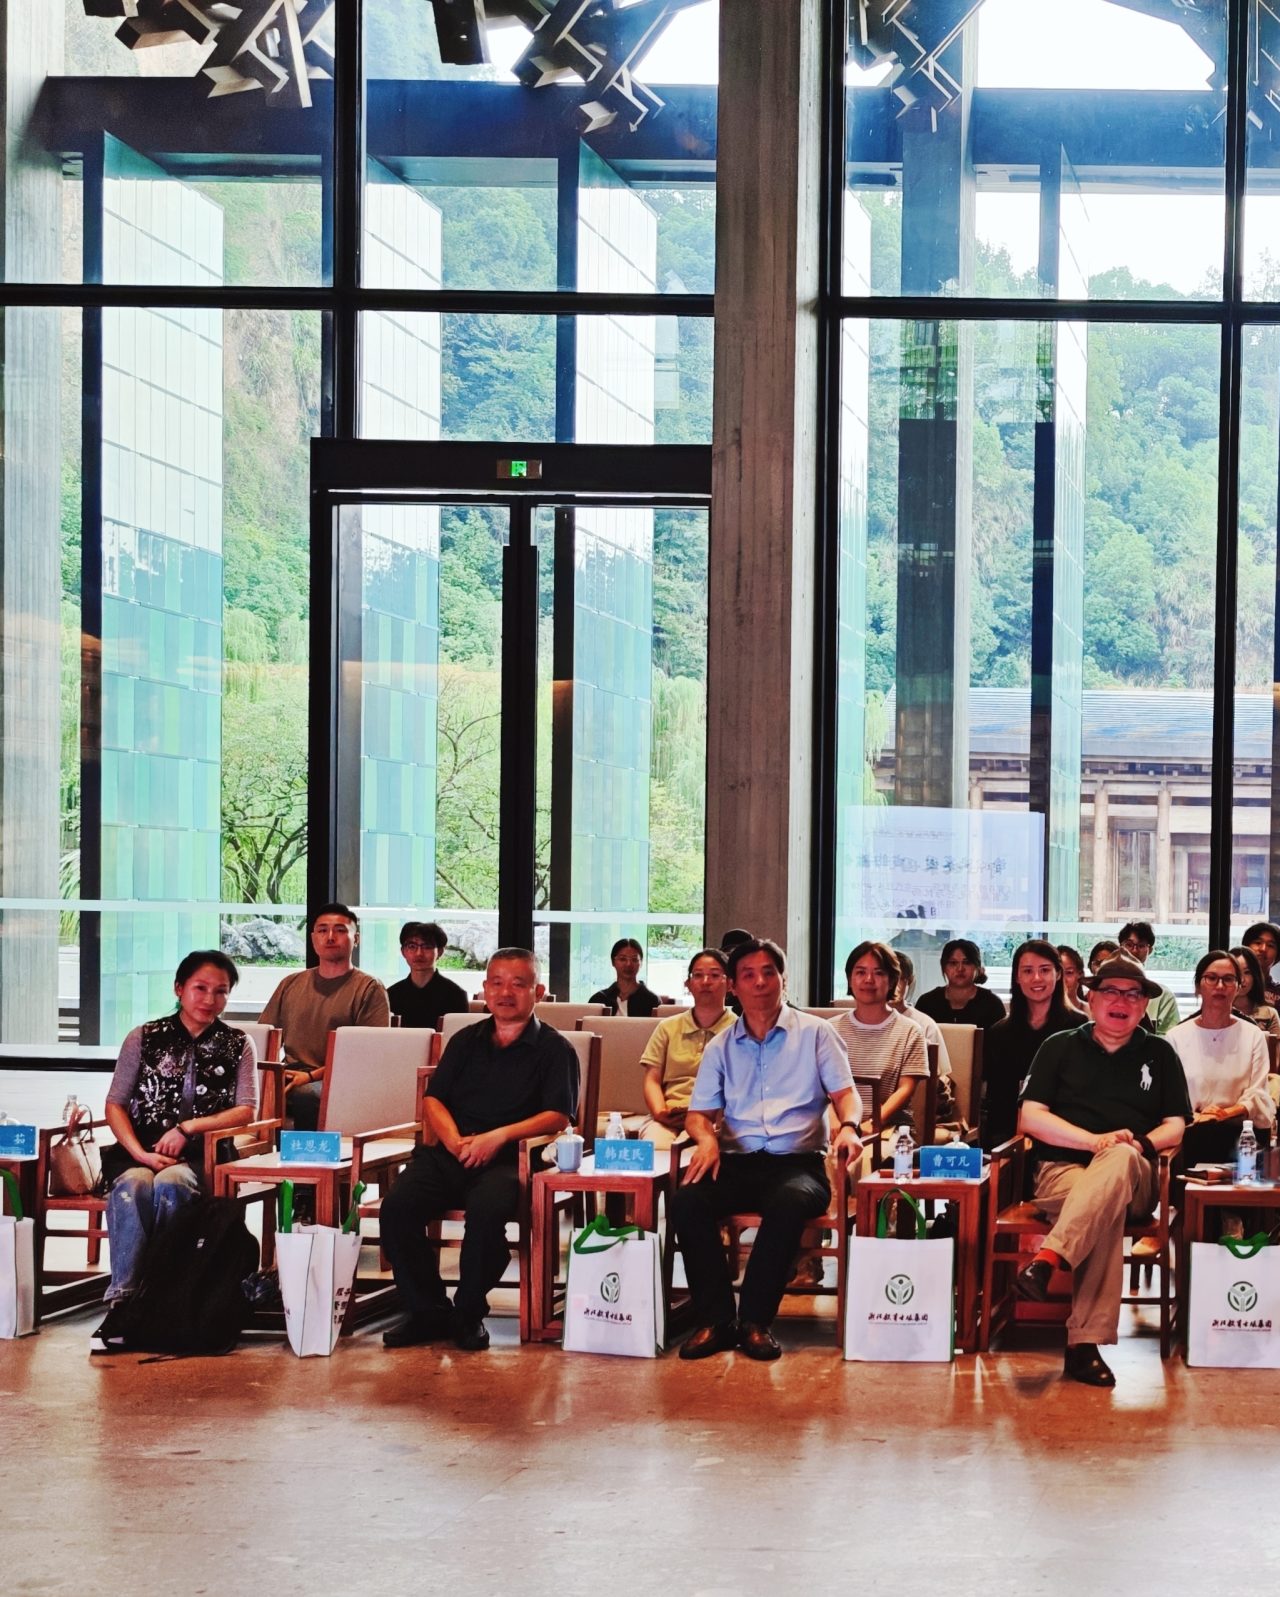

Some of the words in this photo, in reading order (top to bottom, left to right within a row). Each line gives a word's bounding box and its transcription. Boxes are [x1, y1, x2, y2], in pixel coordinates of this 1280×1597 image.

[604, 1146, 645, 1161] 韩建民
[933, 1154, 970, 1168] 曹可凡
